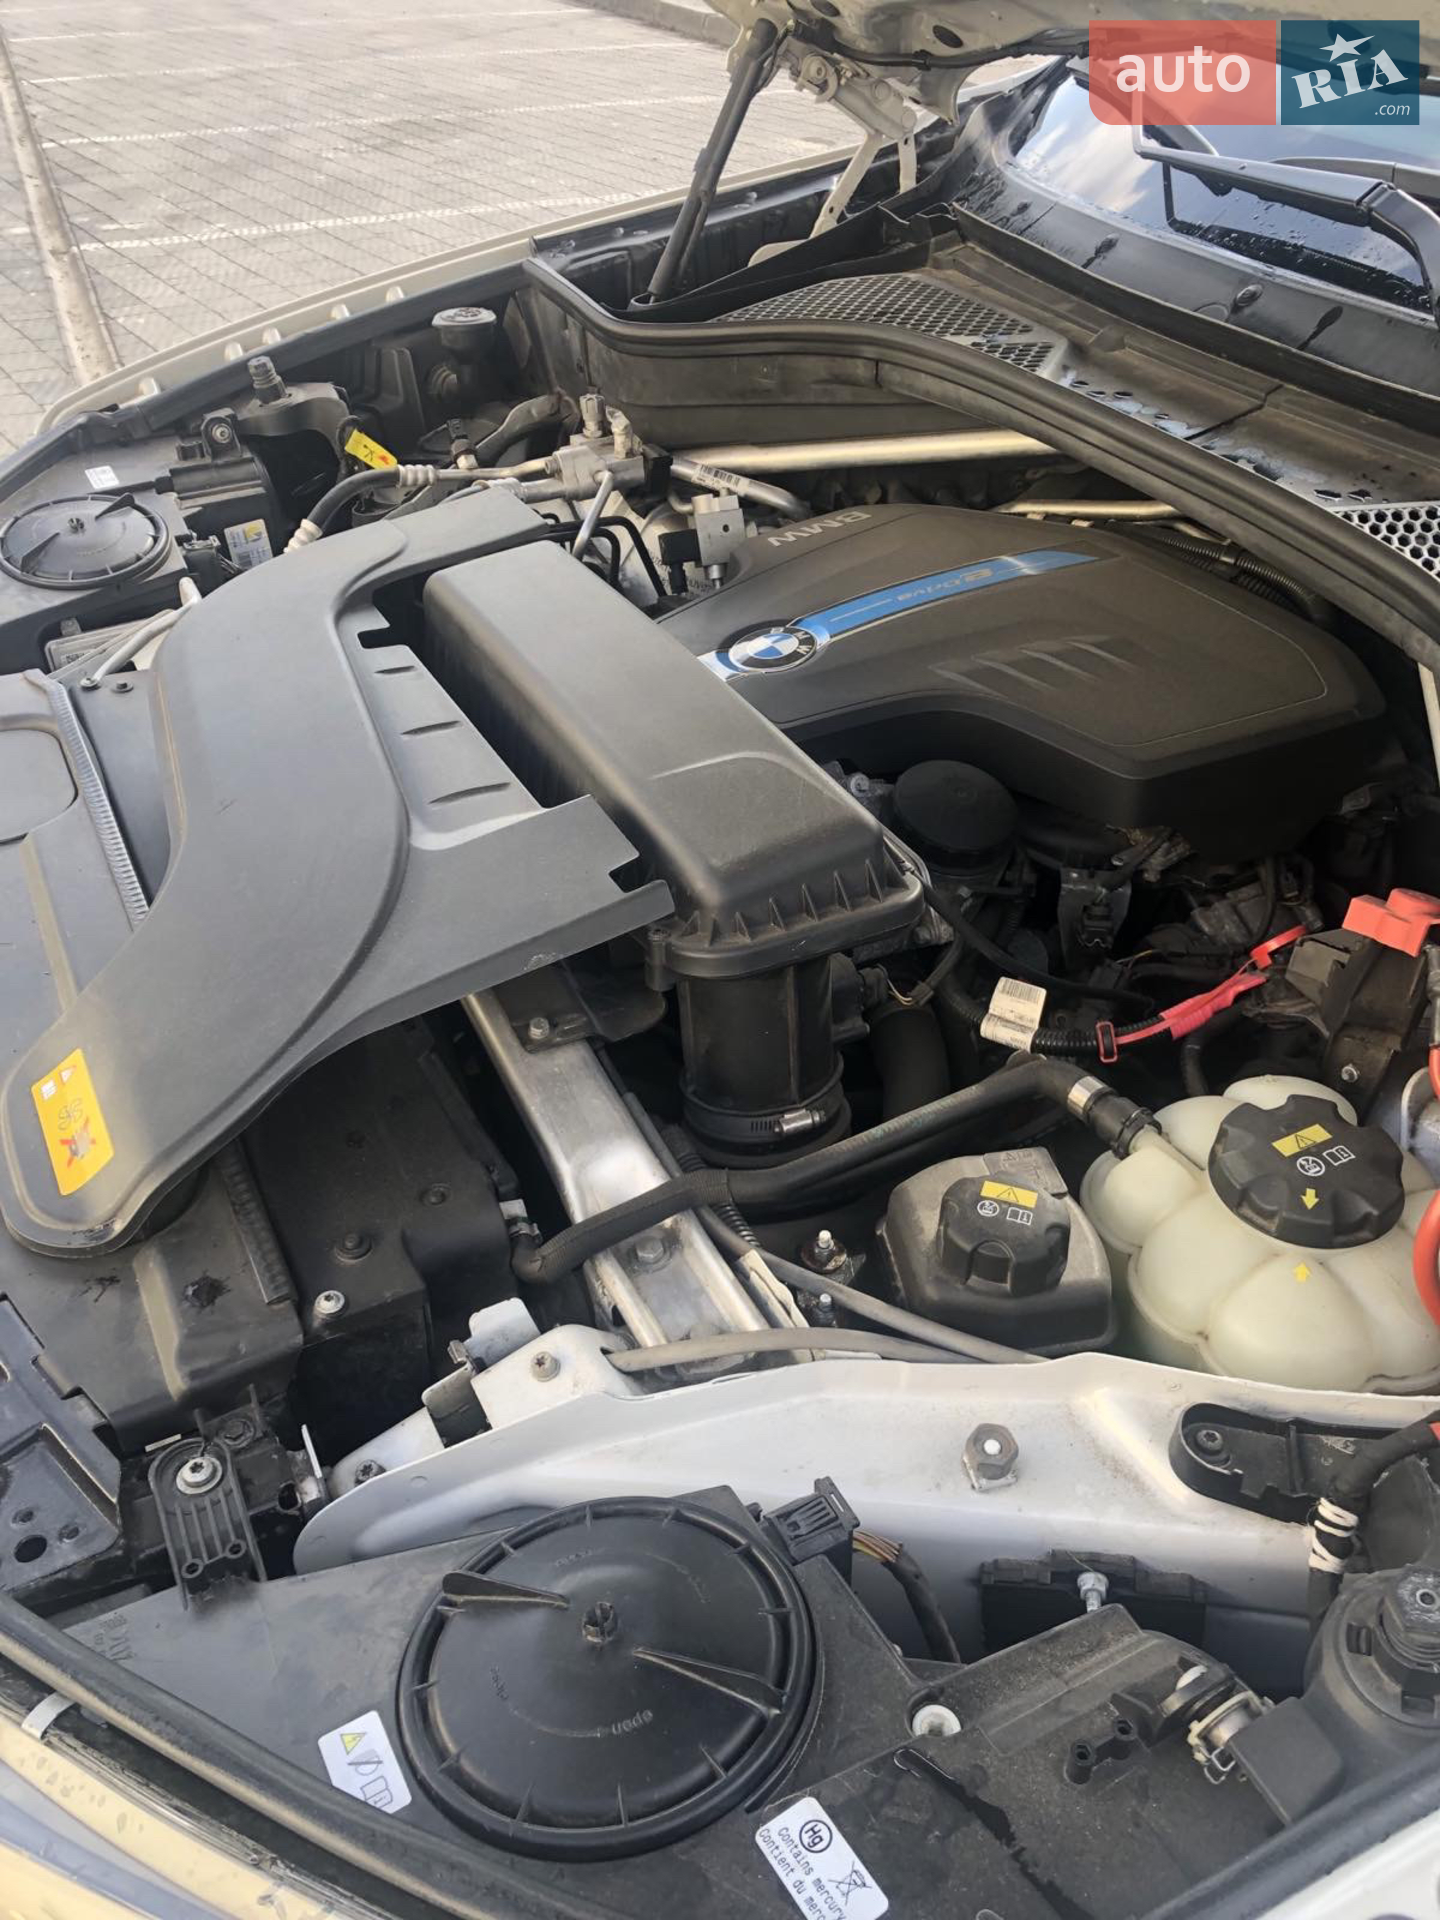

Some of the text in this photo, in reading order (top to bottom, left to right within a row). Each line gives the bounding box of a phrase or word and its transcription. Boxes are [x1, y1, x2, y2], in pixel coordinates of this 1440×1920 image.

[767, 510, 872, 547] BMW
[777, 1826, 814, 1877] Contains
[804, 1823, 825, 1849] Hg
[759, 1827, 796, 1878] Contient
[792, 1879, 807, 1895] du
